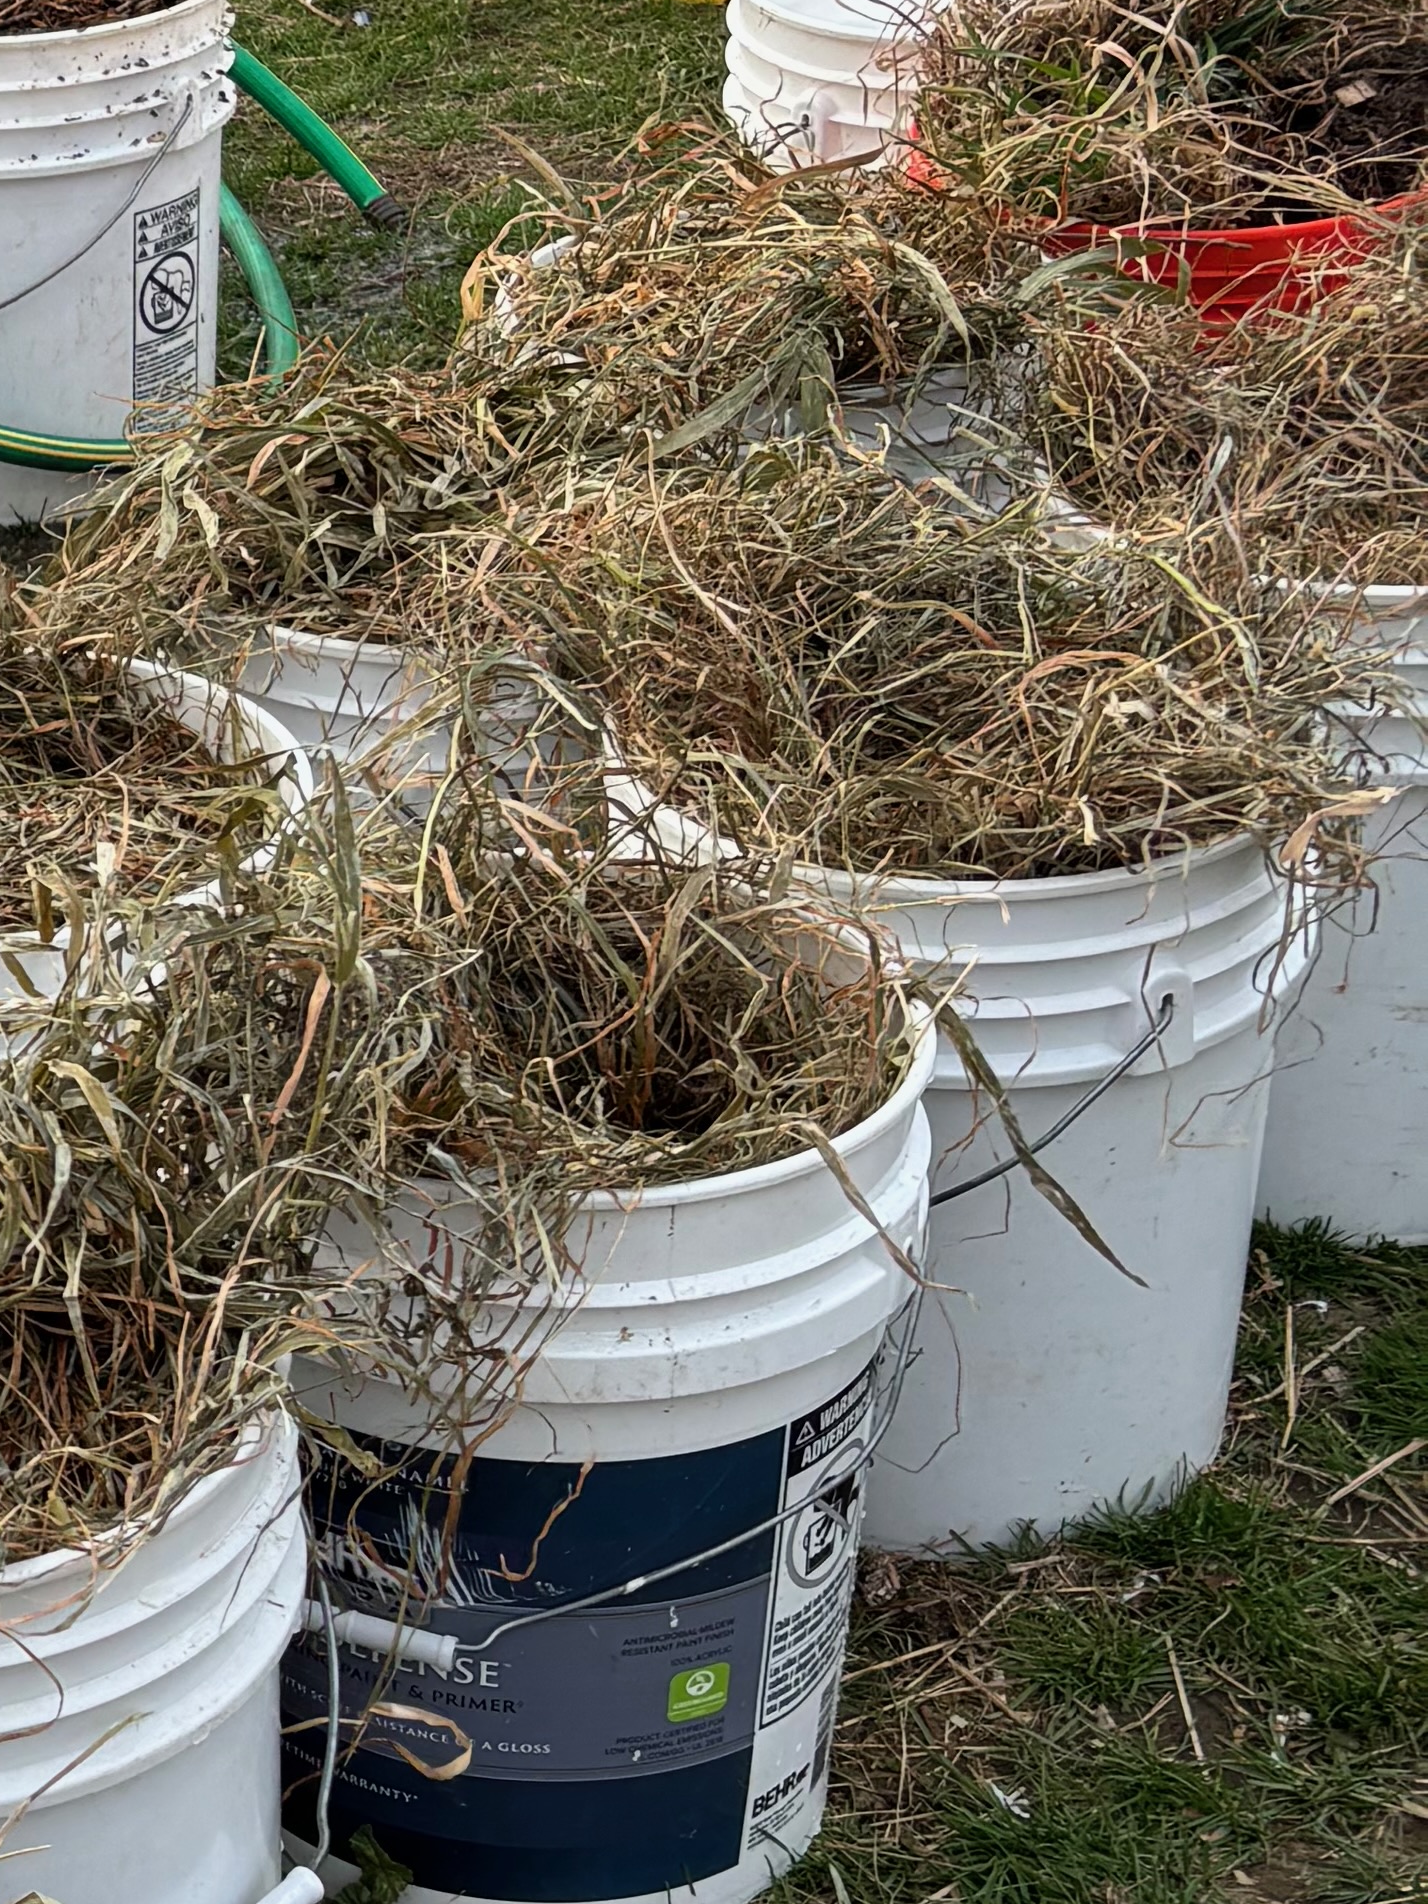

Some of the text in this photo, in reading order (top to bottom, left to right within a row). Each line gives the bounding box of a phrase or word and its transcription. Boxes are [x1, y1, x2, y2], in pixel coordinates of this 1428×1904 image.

[621, 1643, 673, 1656] RESISTANT
[676, 1637, 702, 1648] PAINT
[408, 1684, 424, 1701] &
[374, 1716, 449, 1745] ISTANCE
[482, 1741, 492, 1751] A
[497, 1742, 551, 1755] GLOSS
[616, 1732, 660, 1745] PRODUCT
[752, 1771, 796, 1819] BEHR
